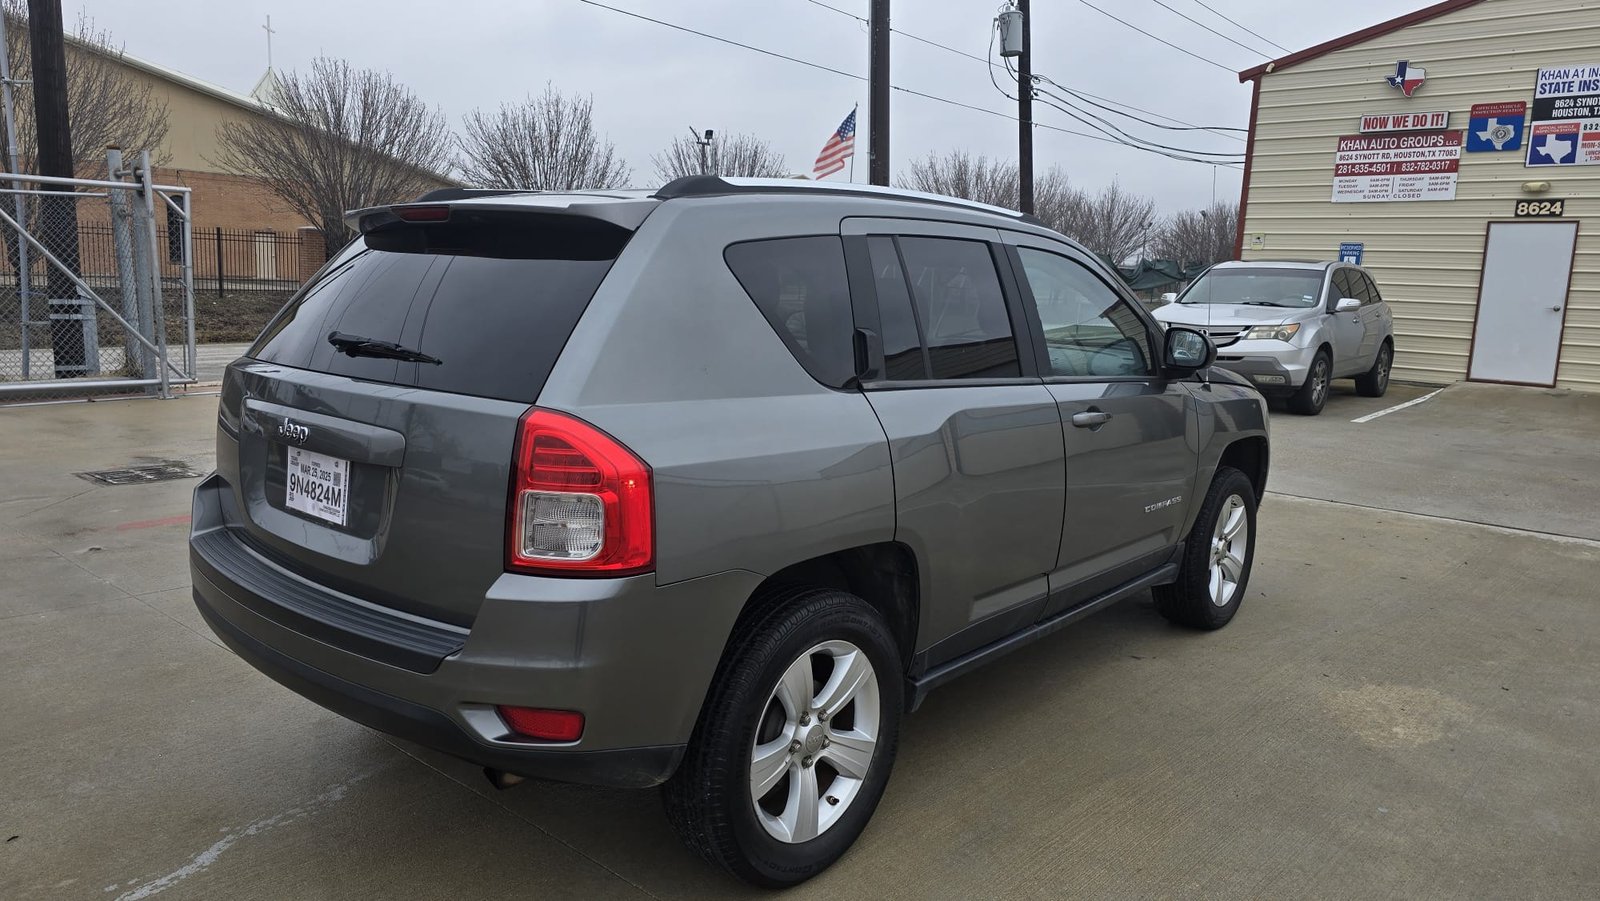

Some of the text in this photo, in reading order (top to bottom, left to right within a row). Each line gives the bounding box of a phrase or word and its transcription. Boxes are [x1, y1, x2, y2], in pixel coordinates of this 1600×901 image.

[1540, 67, 1600, 81] KHAN A1 IN
[1539, 81, 1575, 95] STATE
[1555, 99, 1575, 108] 8624
[1552, 106, 1591, 118] HOUSTON,
[1363, 113, 1445, 130] NOW WE DO IT!
[1339, 140, 1368, 151] KHAN
[1369, 138, 1398, 150] AUTO
[1400, 135, 1444, 148] GROUPS
[1338, 154, 1354, 162] 8624
[1354, 152, 1380, 161] SYNOTT
[1381, 152, 1392, 160] RD,
[1337, 160, 1450, 174] 281-835-4501 832-782-0317
[1516, 201, 1562, 216] 8624
[278, 417, 310, 445] Jeep
[300, 464, 311, 476] MAR
[319, 469, 332, 482] 2025
[289, 473, 342, 508] 9N4824M
[1144, 495, 1182, 513] COMPASS
